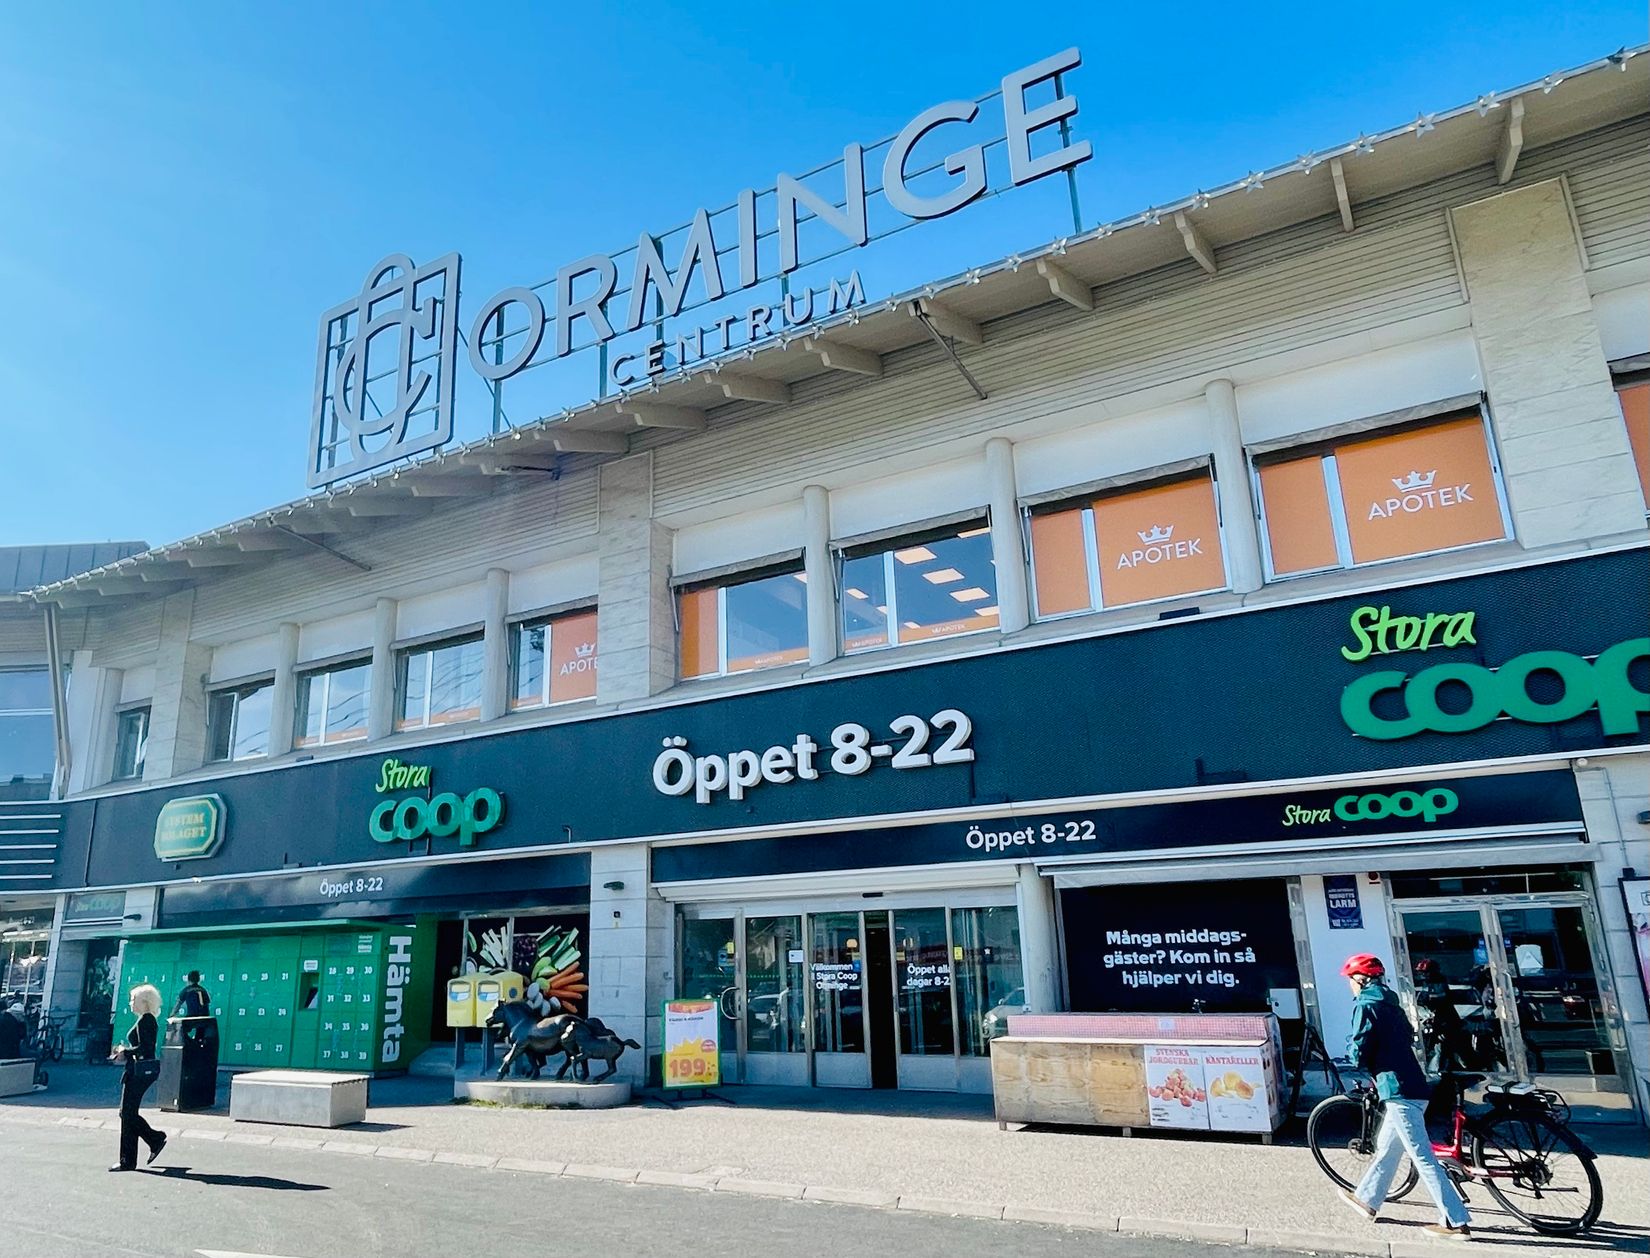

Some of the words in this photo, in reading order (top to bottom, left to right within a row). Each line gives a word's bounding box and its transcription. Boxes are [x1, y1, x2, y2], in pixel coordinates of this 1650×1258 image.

[469, 46, 1093, 381] ORMINGE
[609, 270, 866, 386] CENTRUM
[1367, 483, 1474, 521] APOTEK
[1116, 537, 1203, 570] APOTEK
[1341, 605, 1476, 661] Stora
[560, 656, 598, 676] APOTE
[1340, 637, 1650, 740] coop
[652, 734, 818, 804] Öppet
[830, 708, 975, 775] 8-22
[375, 758, 432, 793] Stora
[369, 787, 505, 847] coop
[1282, 804, 1331, 827] Stora
[1334, 788, 1459, 823] coop
[966, 826, 1035, 852] Öppet
[1041, 820, 1097, 843] 8-22
[320, 878, 354, 898] Öppet
[356, 877, 384, 893] 8-22
[1329, 898, 1357, 909] LARM
[1105, 930, 1162, 948] Många
[1164, 929, 1247, 946] middags-
[907, 962, 936, 976] Öppet
[1103, 950, 1166, 968] gäster?
[1169, 949, 1211, 964] Kom
[1213, 948, 1231, 963] in
[1234, 947, 1256, 963] så
[816, 971, 836, 981] Stora
[837, 971, 858, 982] Coop
[906, 977, 932, 988] dagar
[934, 976, 950, 987] 8-2
[1121, 970, 1182, 988] hjälper
[1185, 970, 1203, 984] vi
[1206, 969, 1240, 988] dig.
[382, 936, 412, 1063] Hämta
[1155, 1048, 1189, 1057] SVENSKA
